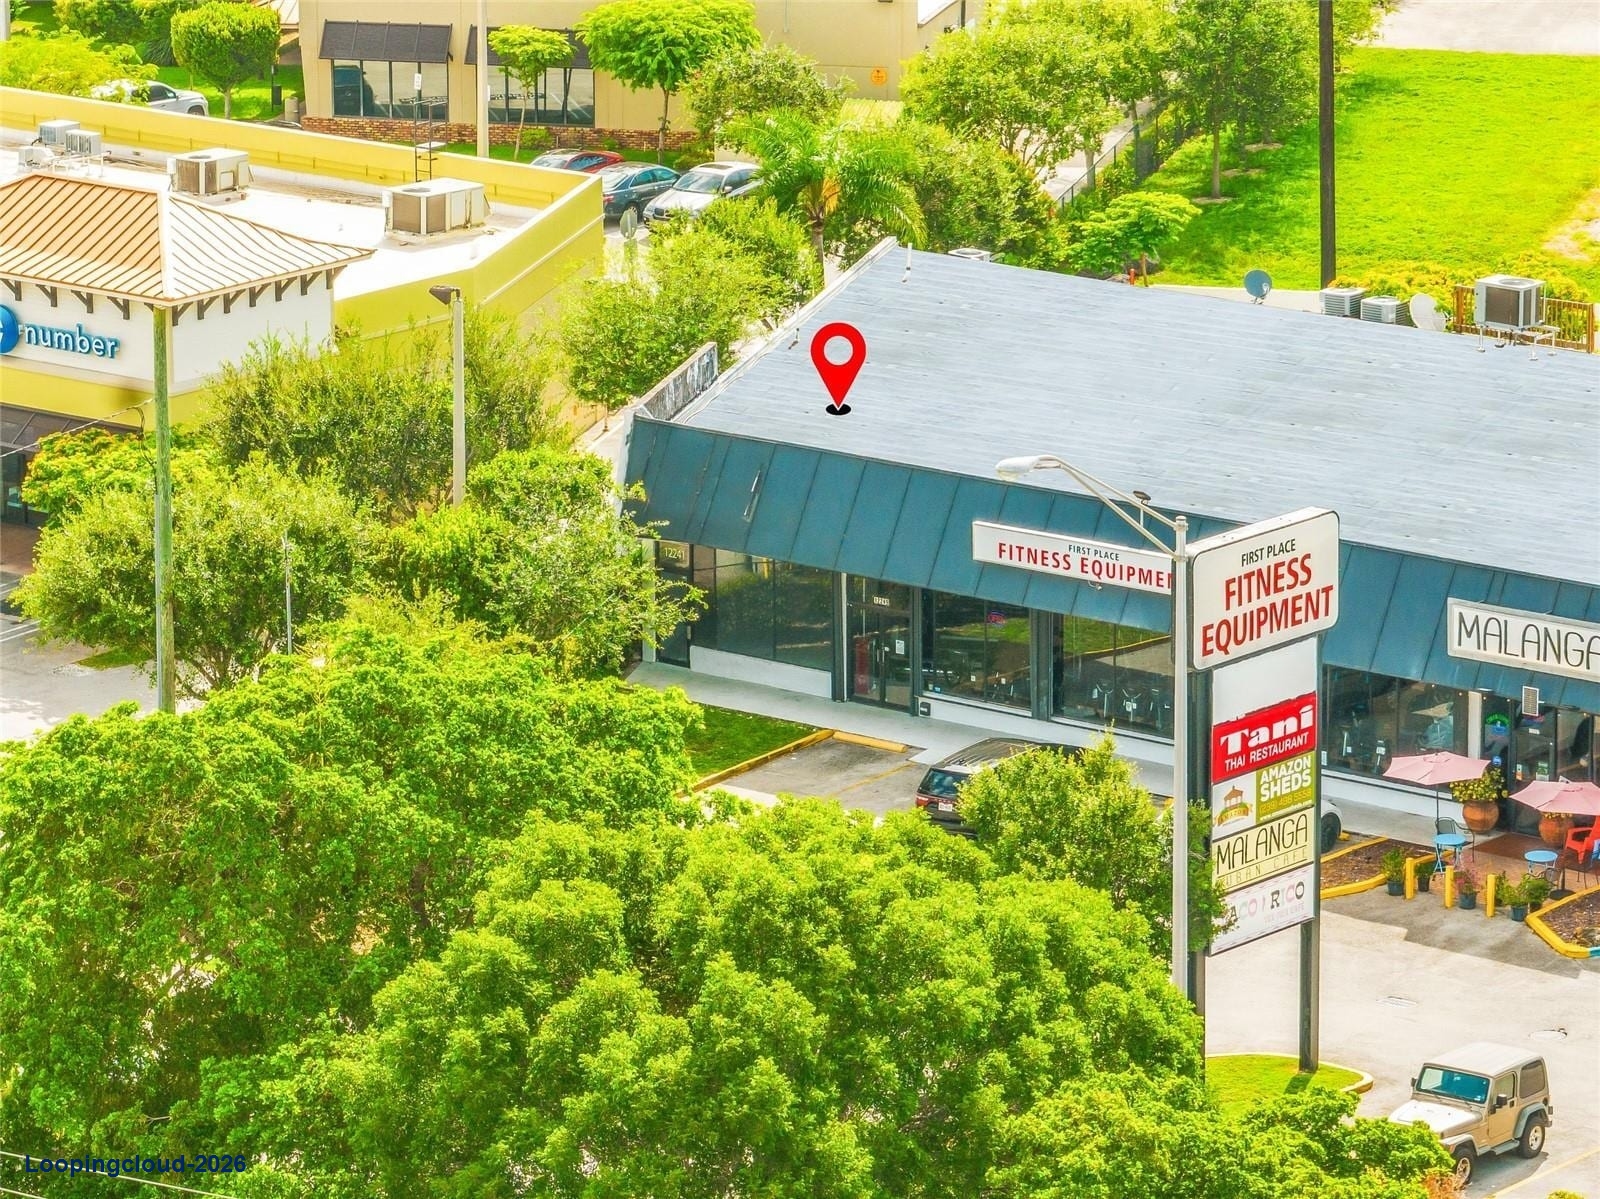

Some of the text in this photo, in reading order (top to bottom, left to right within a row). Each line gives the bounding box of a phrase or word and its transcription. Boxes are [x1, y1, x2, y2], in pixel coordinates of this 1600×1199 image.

[25, 322, 119, 358] number
[664, 547, 685, 560] 12241
[998, 542, 1174, 590] FITNESS EQUIPME
[1068, 544, 1120, 561] FIRST PLACE
[1241, 538, 1296, 568] FIRST PLACE
[1225, 553, 1312, 611] FITNESS
[1202, 585, 1334, 657] EQUIPMENT
[1458, 611, 1600, 670] MALANGA
[1220, 704, 1313, 755] Tani
[1225, 732, 1309, 772] THAI RESTAURANT
[1260, 755, 1311, 785] AMAZON
[1260, 768, 1312, 802] SHEDS
[1217, 813, 1308, 875] MALANGA
[1221, 865, 1262, 887] UBAN
[1229, 897, 1257, 921] ACO
